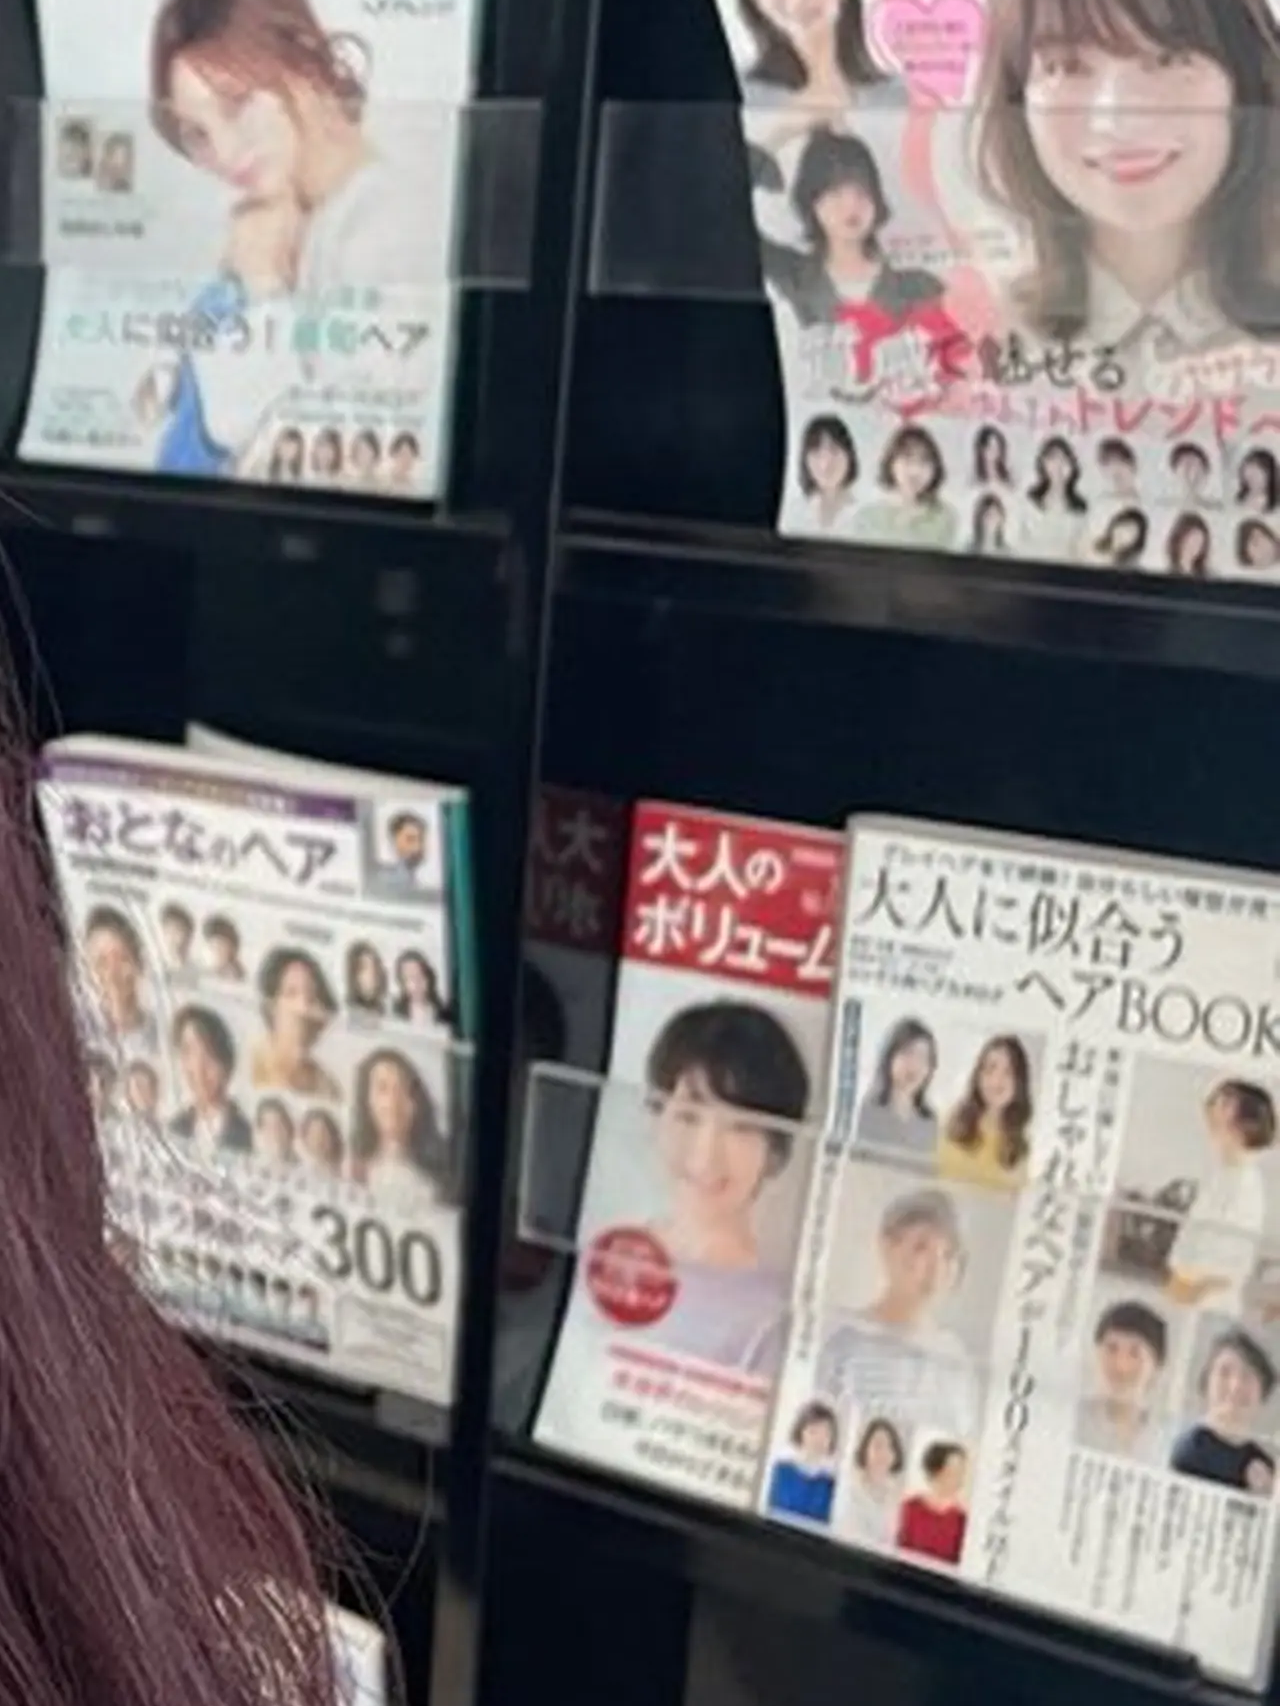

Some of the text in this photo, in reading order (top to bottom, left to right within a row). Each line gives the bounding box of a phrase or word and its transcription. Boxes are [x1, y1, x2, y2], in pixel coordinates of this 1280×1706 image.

[62, 793, 338, 885] おとなのヘア
[641, 820, 784, 899] 大人の
[848, 863, 1186, 973] 大人に似合う
[1014, 967, 1280, 1059] ヘアBOOK
[310, 1204, 443, 1308] 300
